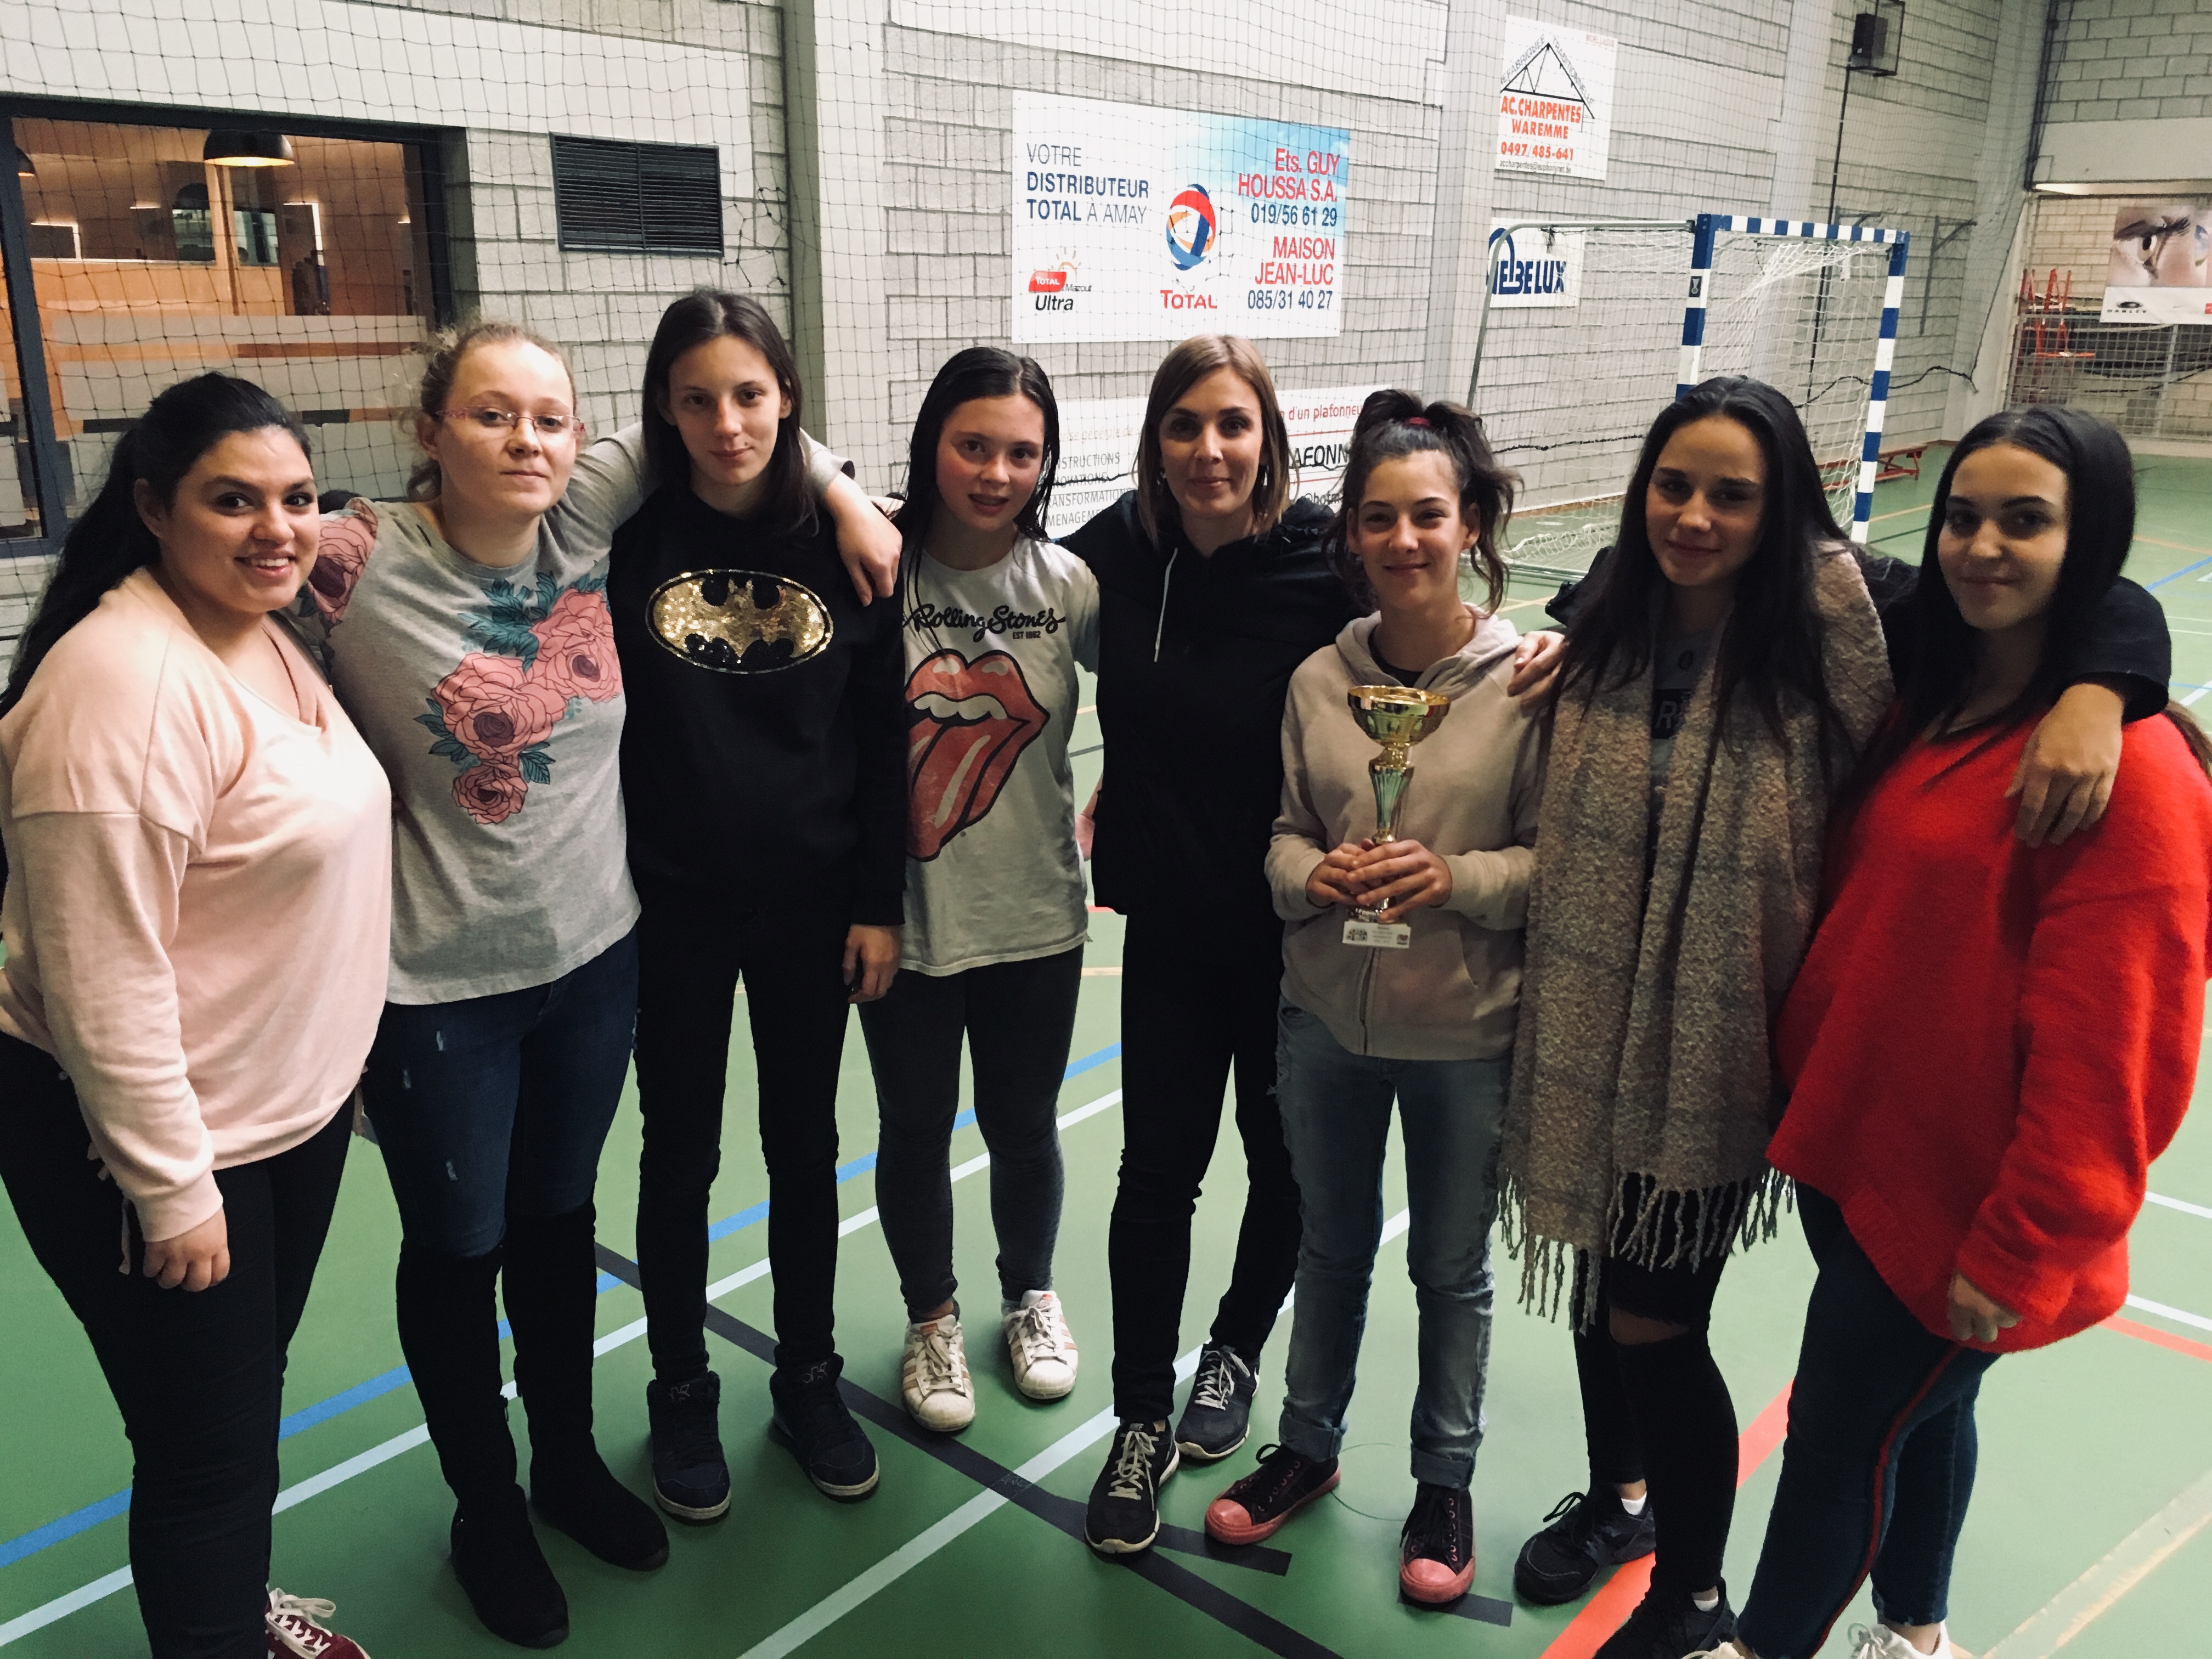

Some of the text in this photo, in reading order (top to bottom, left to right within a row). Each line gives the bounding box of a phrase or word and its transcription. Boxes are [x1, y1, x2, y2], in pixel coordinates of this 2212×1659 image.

[1511, 119, 1568, 139] WAREMME
[1026, 143, 1082, 167] VOTRE
[1275, 148, 1340, 176] Ets. GUY
[1027, 171, 1149, 199] DISTRIBUTEUR
[1238, 173, 1338, 202] HOUSSA S.A.
[1026, 196, 1147, 224] TOTAL À AMAY
[1251, 202, 1338, 227] 019/56 61 29
[1273, 236, 1335, 260] MAISON
[1035, 276, 1060, 285] TOTAL
[1255, 262, 1334, 285] JEAN-LUC
[1487, 260, 1567, 295] EBELUX
[1035, 295, 1074, 311] Ultra
[1160, 289, 1218, 309] TOTAL
[1248, 289, 1333, 309] 085/31 40 27
[1288, 406, 1310, 421] d'un
[902, 603, 1066, 642] Rolling Stones
[1012, 630, 1041, 640] EST 1962
